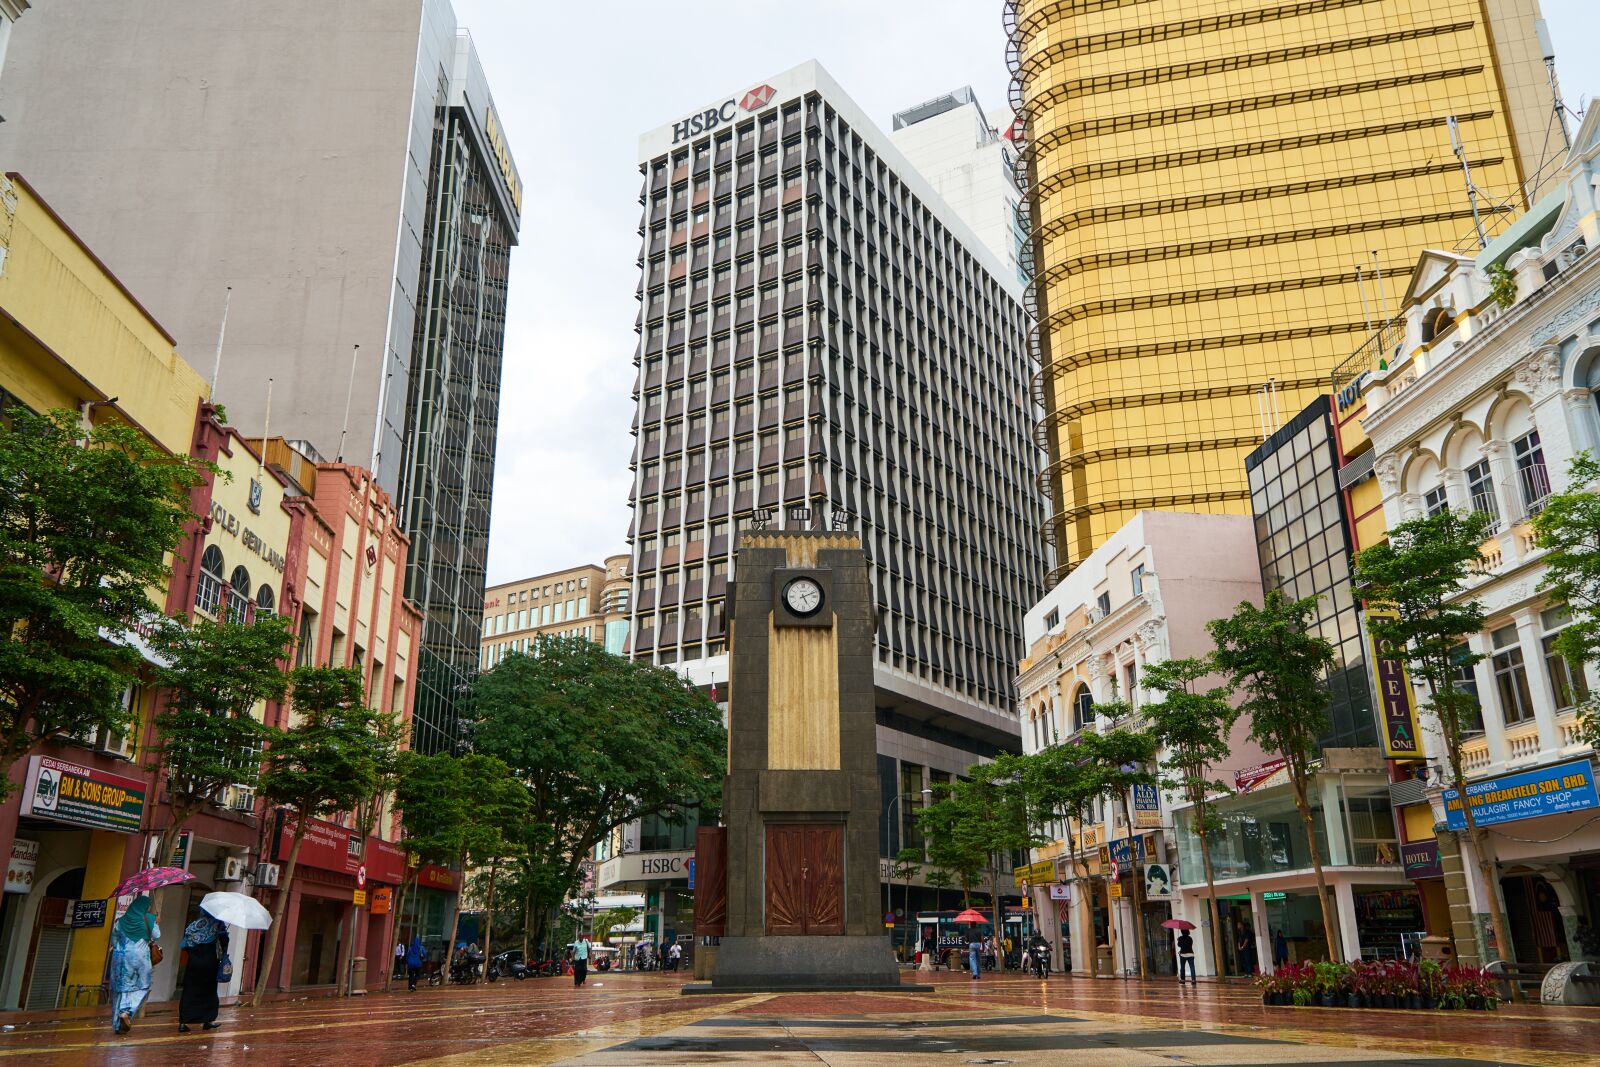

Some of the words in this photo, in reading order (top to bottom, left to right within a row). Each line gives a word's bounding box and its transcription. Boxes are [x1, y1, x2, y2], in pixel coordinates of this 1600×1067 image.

[672, 98, 736, 144] HSBC
[1337, 370, 1370, 412] HOT
[209, 500, 240, 537] KOLEJ
[483, 597, 501, 610] ank
[1376, 619, 1405, 718] OTEL
[1392, 739, 1415, 750] ONE
[42, 758, 57, 769] KEDAI
[61, 776, 75, 796] BM
[74, 780, 81, 798] &
[82, 781, 102, 802] SONS
[102, 786, 126, 807] GROUP
[1444, 790, 1460, 799] KED
[1466, 782, 1498, 795] ERBANEKA
[1447, 794, 1484, 812] AMAING
[1485, 783, 1538, 804] BREAKFIELD
[1538, 778, 1562, 794] SDN.
[1562, 773, 1588, 789] BHD.
[1463, 803, 1510, 819] AULAGIRI
[1513, 796, 1541, 810] FANCY
[1546, 791, 1572, 804] SHOP
[1113, 838, 1140, 856] FARMSI
[641, 857, 681, 875] HSBC
[1405, 852, 1431, 865] HOTEL
[938, 936, 963, 945] JESSIE
